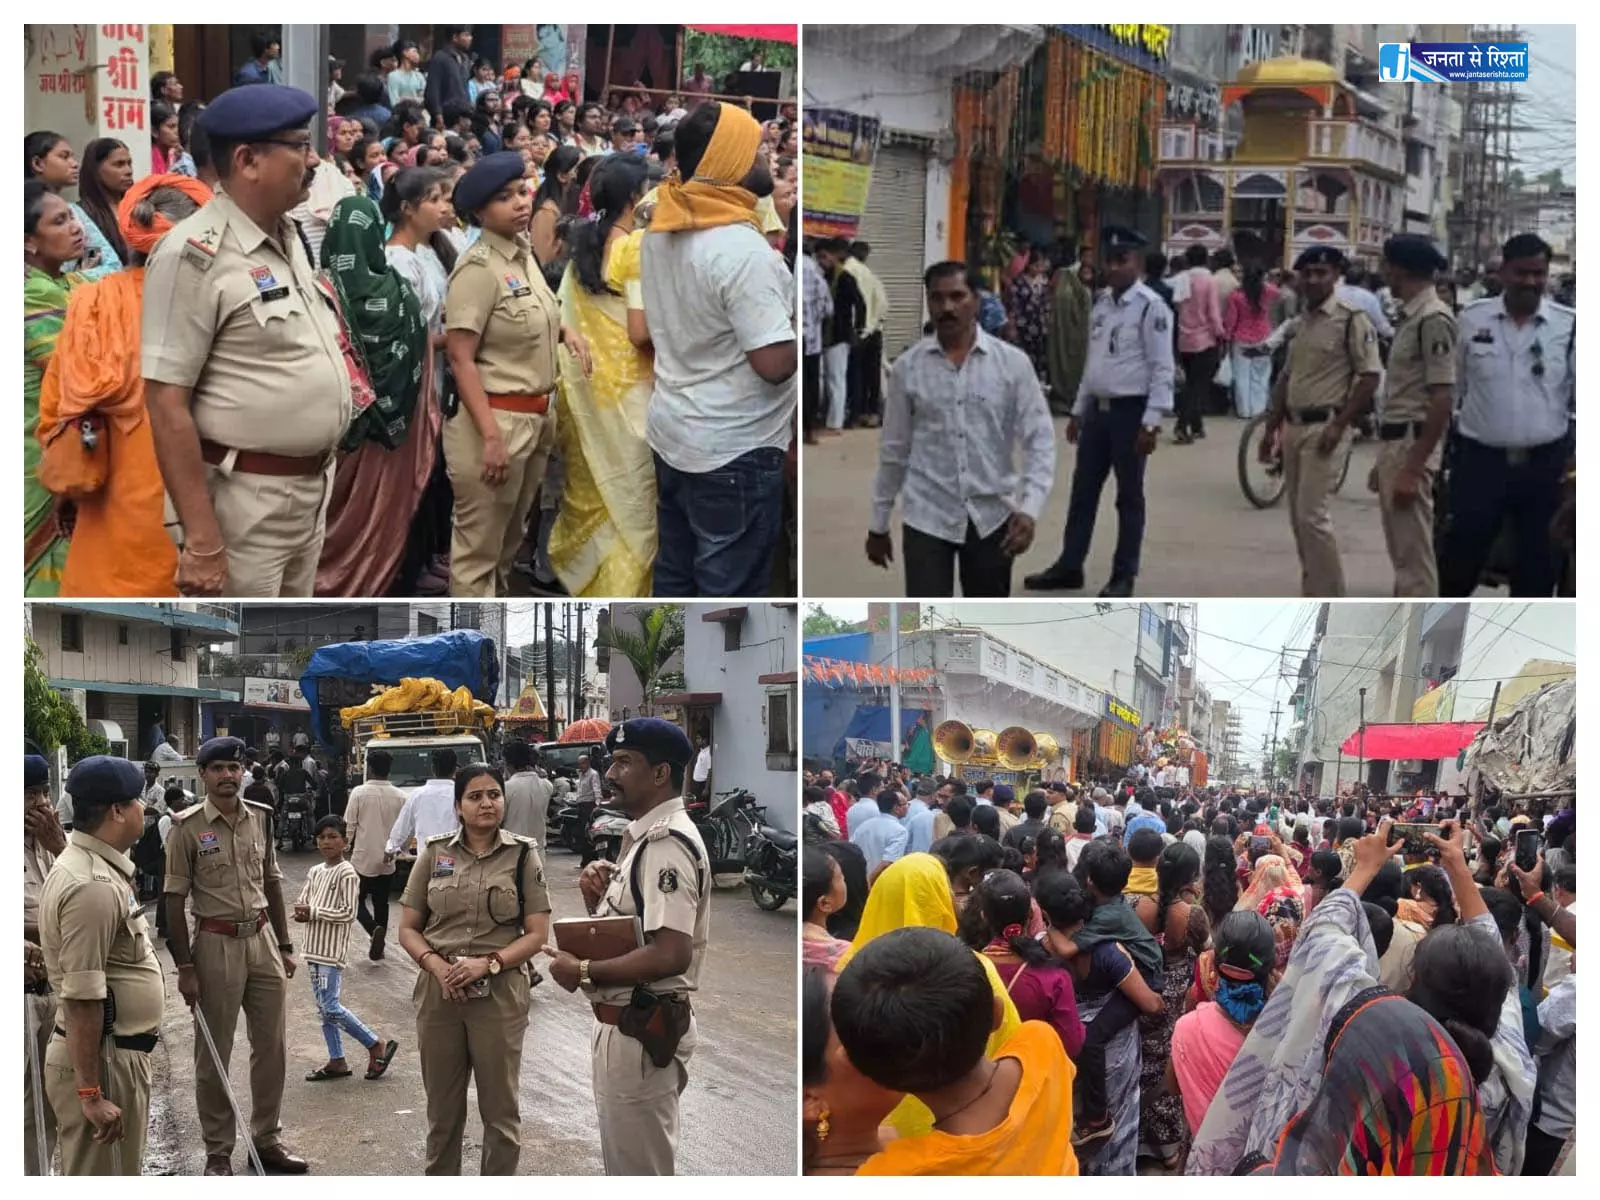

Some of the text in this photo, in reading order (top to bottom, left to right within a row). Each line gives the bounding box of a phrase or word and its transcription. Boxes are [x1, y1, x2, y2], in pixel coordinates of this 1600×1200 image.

[39, 74, 57, 93] जय
[107, 47, 140, 90] श्री
[102, 96, 146, 130] राम
